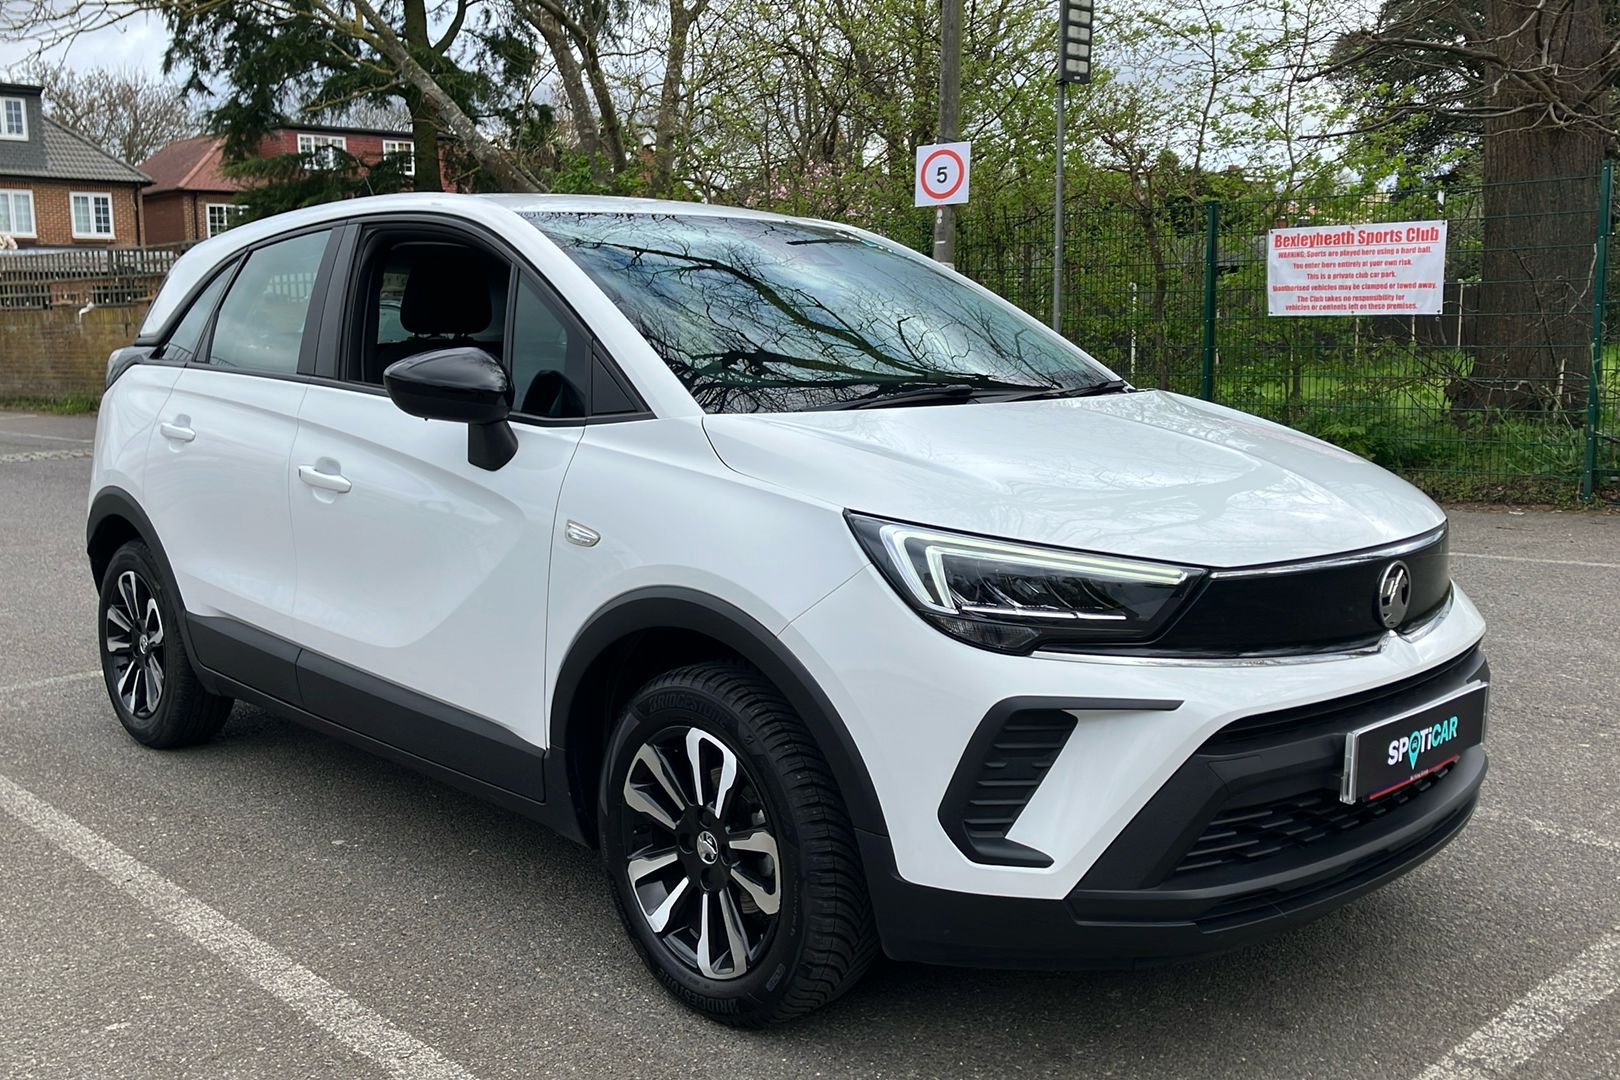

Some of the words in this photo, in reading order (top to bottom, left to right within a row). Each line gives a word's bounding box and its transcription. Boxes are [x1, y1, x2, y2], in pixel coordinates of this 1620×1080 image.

[936, 166, 948, 184] 5
[1274, 231, 1355, 248] Bexleyheath
[1358, 229, 1403, 245] Sports
[1406, 226, 1439, 242] Club
[1307, 250, 1326, 258] Sports
[1340, 249, 1361, 258] played
[1362, 248, 1376, 256] here
[1377, 247, 1394, 256] using
[1401, 246, 1416, 254] hard
[1417, 245, 1432, 254] ball.
[1338, 260, 1361, 269] entirely
[1369, 260, 1383, 268] your
[1307, 272, 1319, 280] This
[1333, 272, 1355, 280] private
[1356, 271, 1368, 279] club
[1381, 270, 1396, 279] park.
[1311, 283, 1337, 291] vehicles
[1338, 283, 1352, 291] may
[1361, 282, 1388, 290] clamped
[1397, 281, 1417, 289] towed
[1325, 294, 1343, 302] takes
[1353, 293, 1394, 302] responsibility
[1285, 303, 1310, 311] vehicles
[1319, 303, 1347, 311] contents
[1348, 302, 1359, 310] left
[1368, 302, 1386, 310] these
[1387, 302, 1418, 311] premises.
